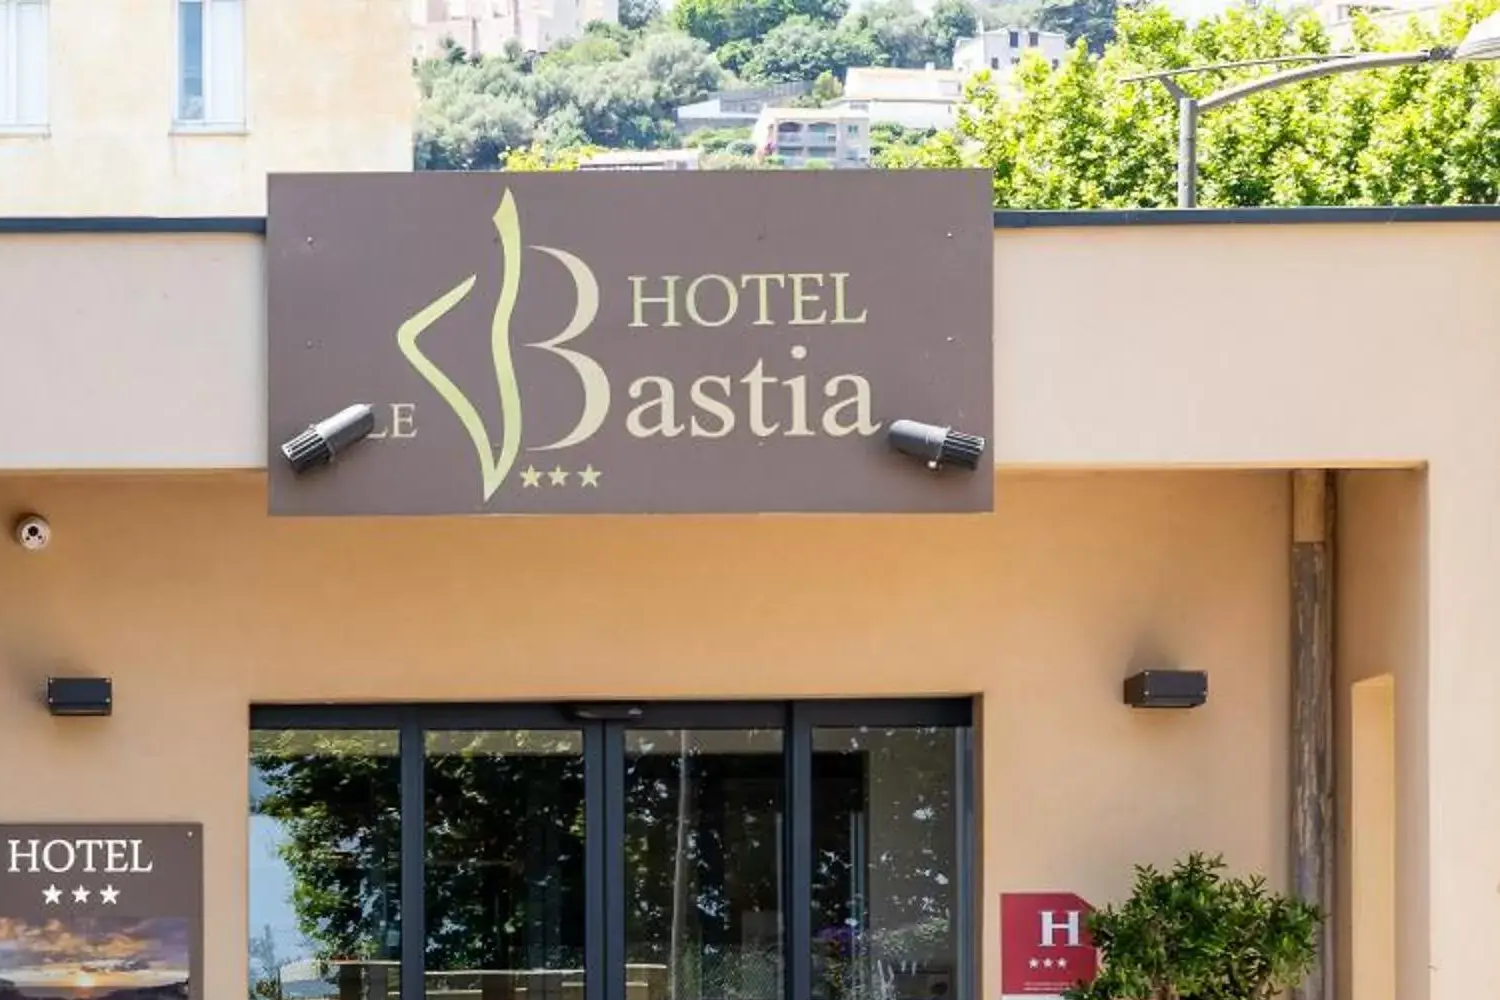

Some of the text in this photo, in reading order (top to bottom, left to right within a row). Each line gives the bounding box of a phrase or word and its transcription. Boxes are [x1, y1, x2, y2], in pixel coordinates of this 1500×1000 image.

[628, 271, 869, 328] HOTEL
[491, 242, 882, 452] Bastia
[8, 839, 153, 874] HOTEL
[1038, 909, 1083, 947] H
